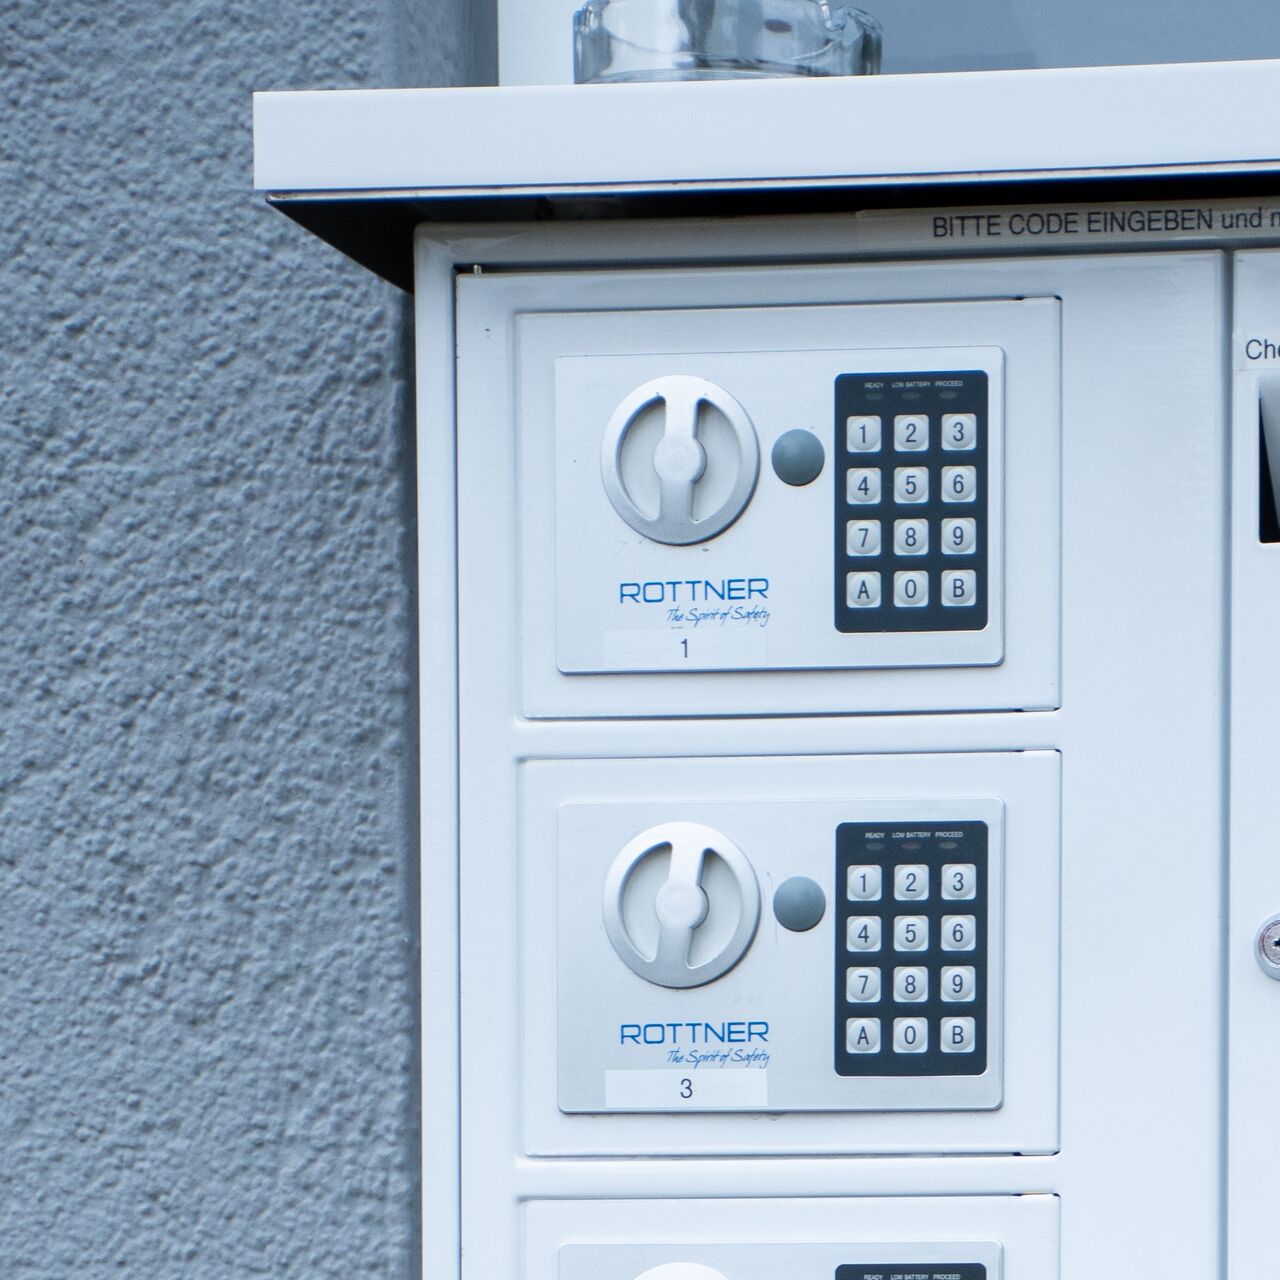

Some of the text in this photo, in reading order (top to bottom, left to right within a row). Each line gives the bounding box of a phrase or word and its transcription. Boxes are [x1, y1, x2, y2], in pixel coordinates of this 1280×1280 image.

[932, 214, 1002, 237] BITTE
[1008, 212, 1079, 236] CODE
[1087, 208, 1213, 233] EINGEBEN
[1221, 207, 1262, 229] und
[905, 423, 918, 444] 2
[952, 421, 966, 443] 3
[857, 474, 966, 497] 4 5 6
[858, 526, 965, 549] 7 8 9
[620, 578, 769, 603] ROTTNER
[857, 578, 966, 601] A 0 B
[667, 606, 769, 627] The Spirit of Safety
[681, 638, 687, 658] 1
[621, 1022, 769, 1044] ROTTNER
[667, 1047, 769, 1068] The Spirit of Safety
[680, 1078, 693, 1098] 3
